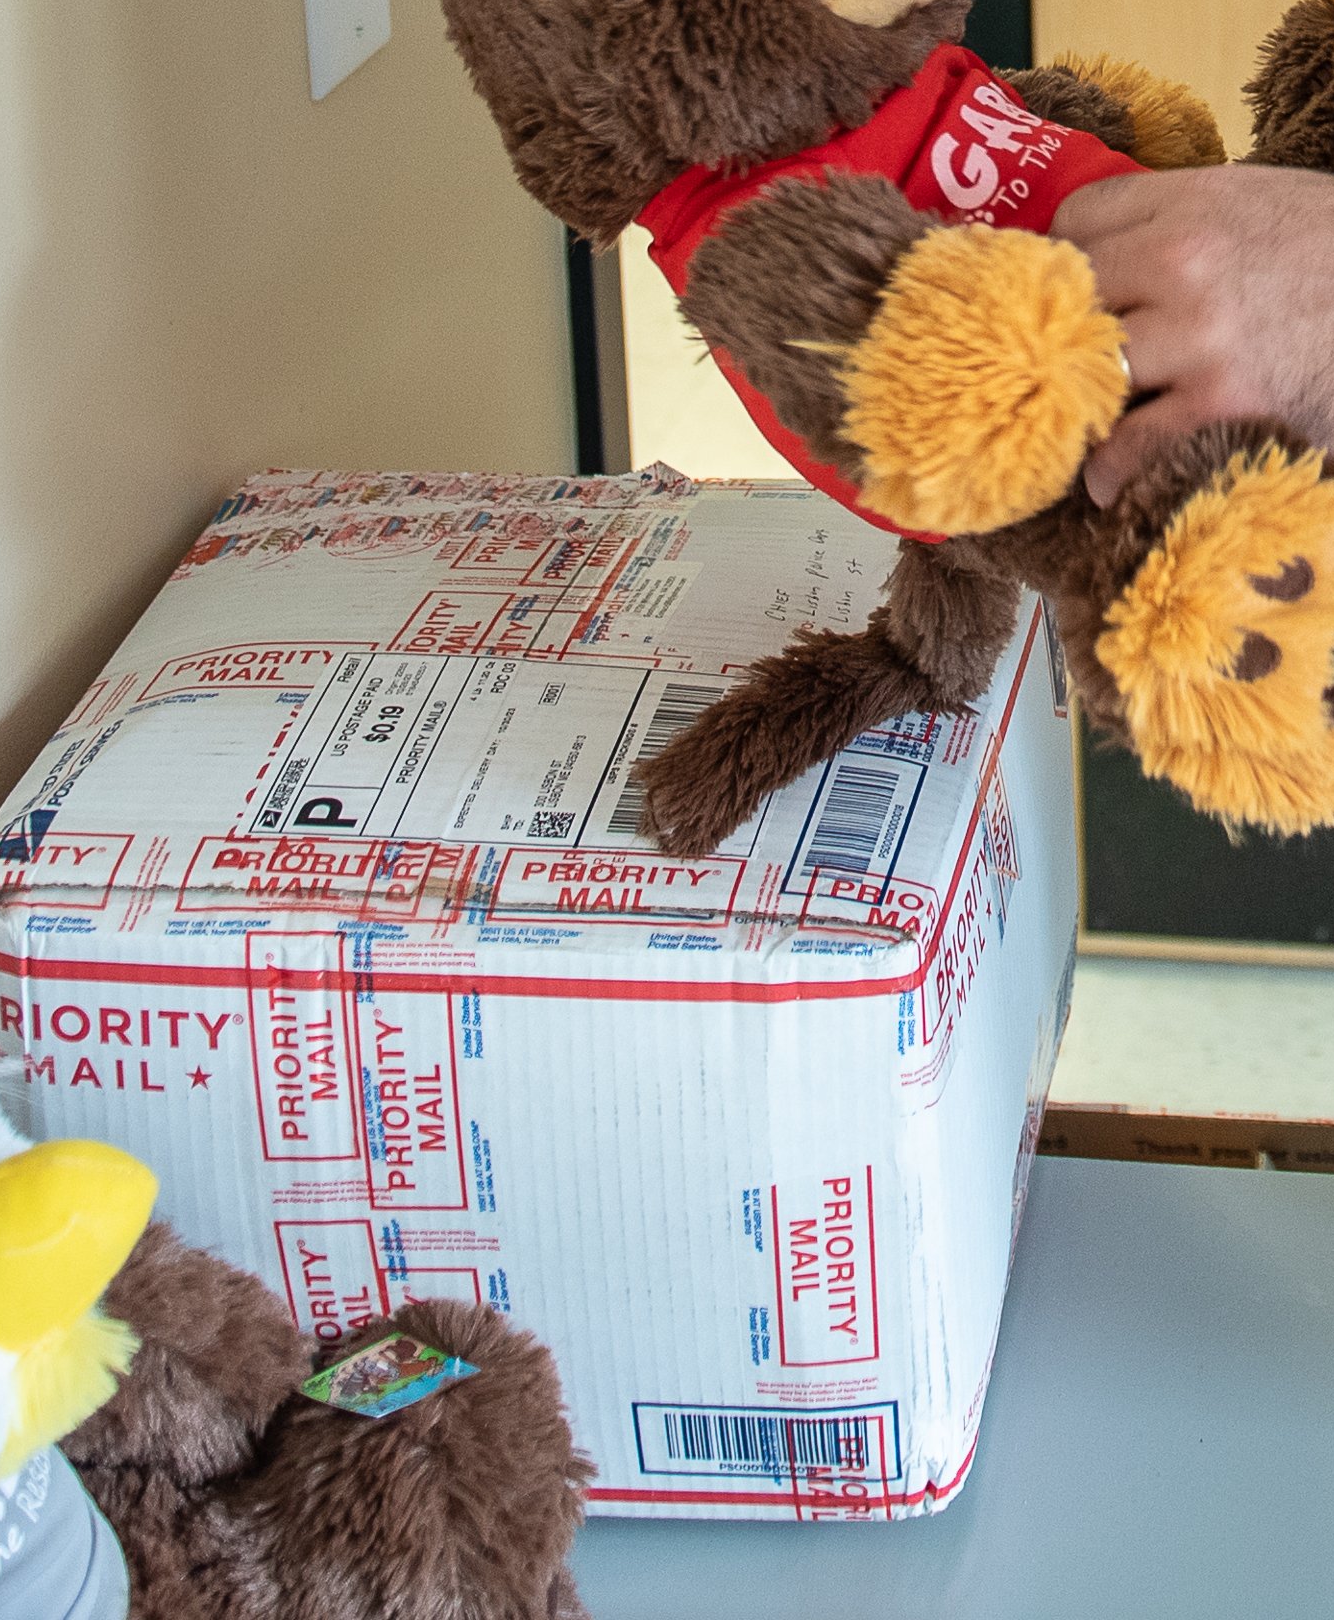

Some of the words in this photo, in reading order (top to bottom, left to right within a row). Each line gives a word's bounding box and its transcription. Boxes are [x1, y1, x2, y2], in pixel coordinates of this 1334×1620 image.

[1019, 134, 1062, 169] The
[765, 589, 790, 622] CHIEF
[198, 663, 285, 682] MAIL
[337, 657, 362, 683] Retail
[491, 674, 510, 694] RDC
[506, 662, 517, 674] 03
[330, 744, 348, 757] US
[339, 699, 372, 741] POSTAGE
[362, 677, 383, 697] PAID
[365, 706, 405, 743] $0.19
[396, 734, 424, 784] PRIORITY
[293, 797, 358, 828] P
[246, 877, 344, 901] MAIL
[557, 887, 651, 913] MAIL
[650, 933, 683, 942] United
[956, 926, 985, 1018] MAIL
[305, 1010, 338, 1101] MAIL
[24, 1054, 165, 1093] MAIL
[414, 1064, 447, 1152] MAIL
[789, 1219, 820, 1302] MAIL
